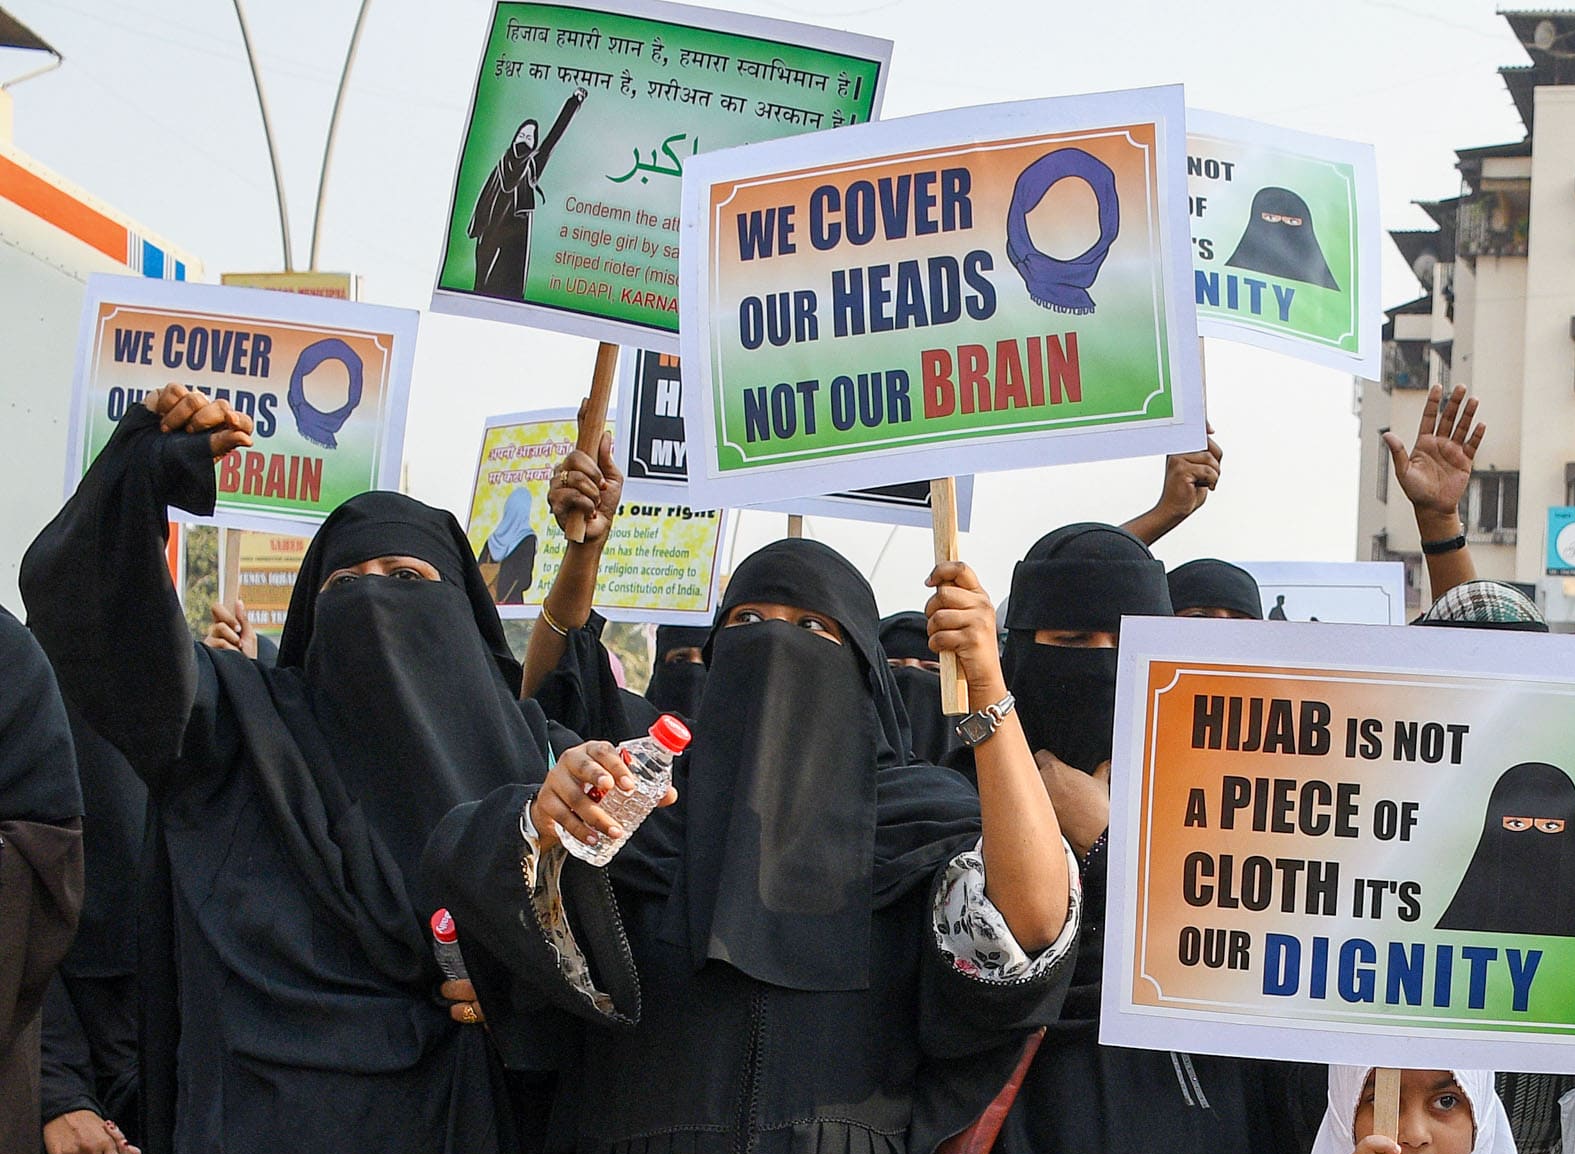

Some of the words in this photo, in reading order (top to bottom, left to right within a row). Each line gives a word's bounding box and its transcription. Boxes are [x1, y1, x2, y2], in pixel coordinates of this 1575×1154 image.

[505, 18, 550, 43] हिजाब
[556, 28, 602, 50] हमारी
[608, 36, 645, 57] शान
[679, 48, 730, 73] हमारा
[737, 58, 830, 91] स्वाभिमान
[495, 53, 524, 79] ईश्वर
[529, 62, 551, 80] का
[557, 65, 614, 89] फरमान
[720, 93, 748, 114] का
[754, 101, 825, 129] अरकान
[1187, 155, 1235, 181] NOT
[565, 196, 632, 222] Condemn
[635, 209, 658, 228] the
[662, 217, 680, 232] att
[737, 205, 797, 261] WE
[809, 167, 973, 251] COVER
[1189, 195, 1208, 218] F
[555, 251, 600, 270] striped
[603, 259, 641, 279] rioter
[560, 225, 568, 238] a
[572, 226, 612, 248] single
[615, 234, 639, 252] girl
[641, 237, 659, 258] by
[549, 274, 562, 290] in
[620, 287, 680, 313] KARNA
[739, 289, 819, 350] OUR
[831, 250, 997, 338] HEADS
[1194, 269, 1296, 322] NITY
[114, 328, 155, 365] WE
[162, 324, 273, 378] COVER
[743, 379, 820, 443] NOT
[830, 369, 912, 431] OUR
[921, 331, 1083, 420] BRAIN
[219, 449, 323, 502] BRAIN
[630, 505, 662, 516] our
[634, 527, 659, 540] belief
[543, 544, 560, 554] And
[618, 544, 633, 556] has
[635, 545, 651, 557] the
[652, 545, 690, 558] freedom
[543, 562, 552, 573] to
[604, 563, 638, 577] religion
[640, 564, 685, 579] according
[687, 566, 697, 578] to
[608, 580, 663, 595] Constitution
[665, 583, 677, 595] of
[1191, 695, 1331, 756] HIJAB
[1345, 717, 1383, 760] IS
[1394, 720, 1470, 764] NOT
[1183, 788, 1207, 828] A
[1220, 775, 1361, 838] PIECE
[1373, 799, 1420, 841] OF
[1183, 851, 1340, 917] CLOTH
[1352, 878, 1421, 922] IT'S
[1178, 926, 1251, 970] OUR
[1262, 933, 1543, 1012] DIGNITY
